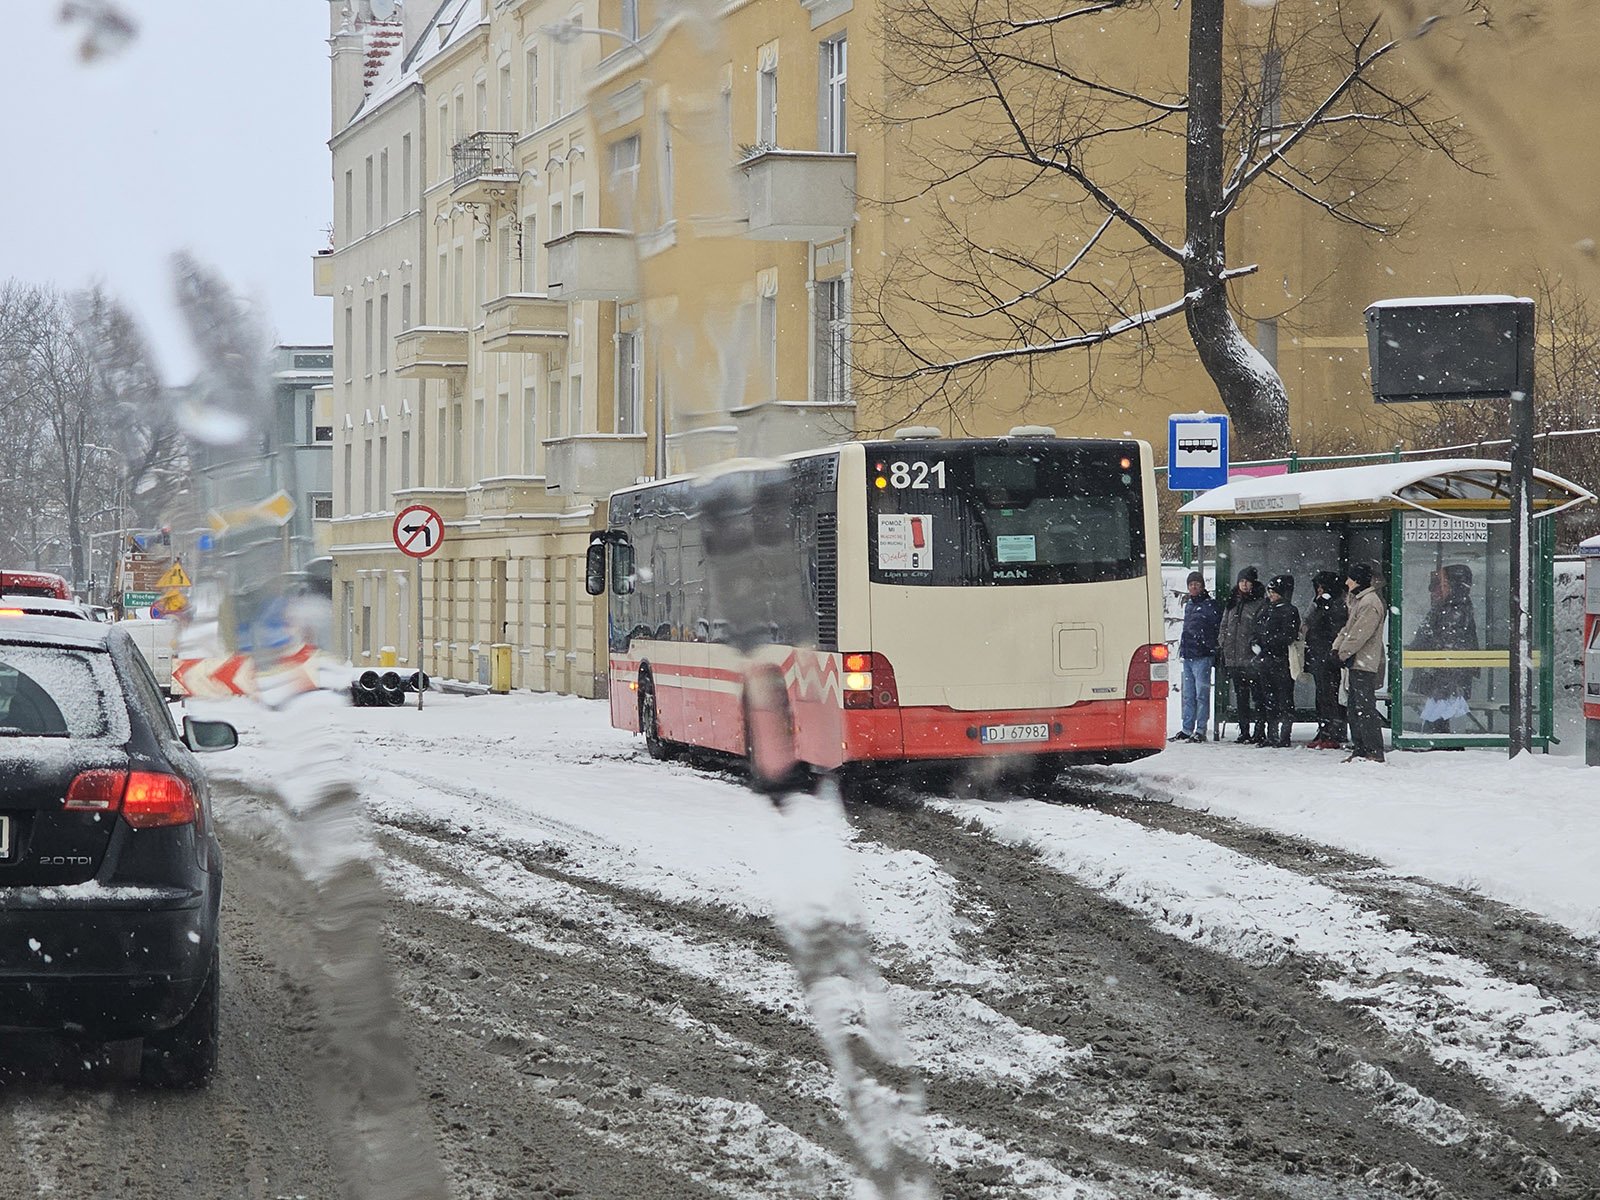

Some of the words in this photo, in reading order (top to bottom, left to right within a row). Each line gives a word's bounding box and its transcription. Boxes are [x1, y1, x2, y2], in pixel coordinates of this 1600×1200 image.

[890, 461, 946, 489] 821
[1408, 520, 1413, 528] 1
[1420, 520, 1425, 528] 2
[1432, 520, 1437, 528] 7
[1443, 520, 1449, 528] 9
[1453, 520, 1461, 528] 11
[1406, 532, 1416, 540] 17
[1418, 532, 1427, 540] 21
[1429, 532, 1439, 540] 22
[1441, 532, 1451, 540] 23
[1453, 532, 1463, 540] 26
[1465, 532, 1475, 540] N1
[1477, 532, 1488, 540] N2
[993, 570, 1028, 579] MAN
[989, 728, 1006, 740] DJ
[1011, 725, 1047, 739] 67982
